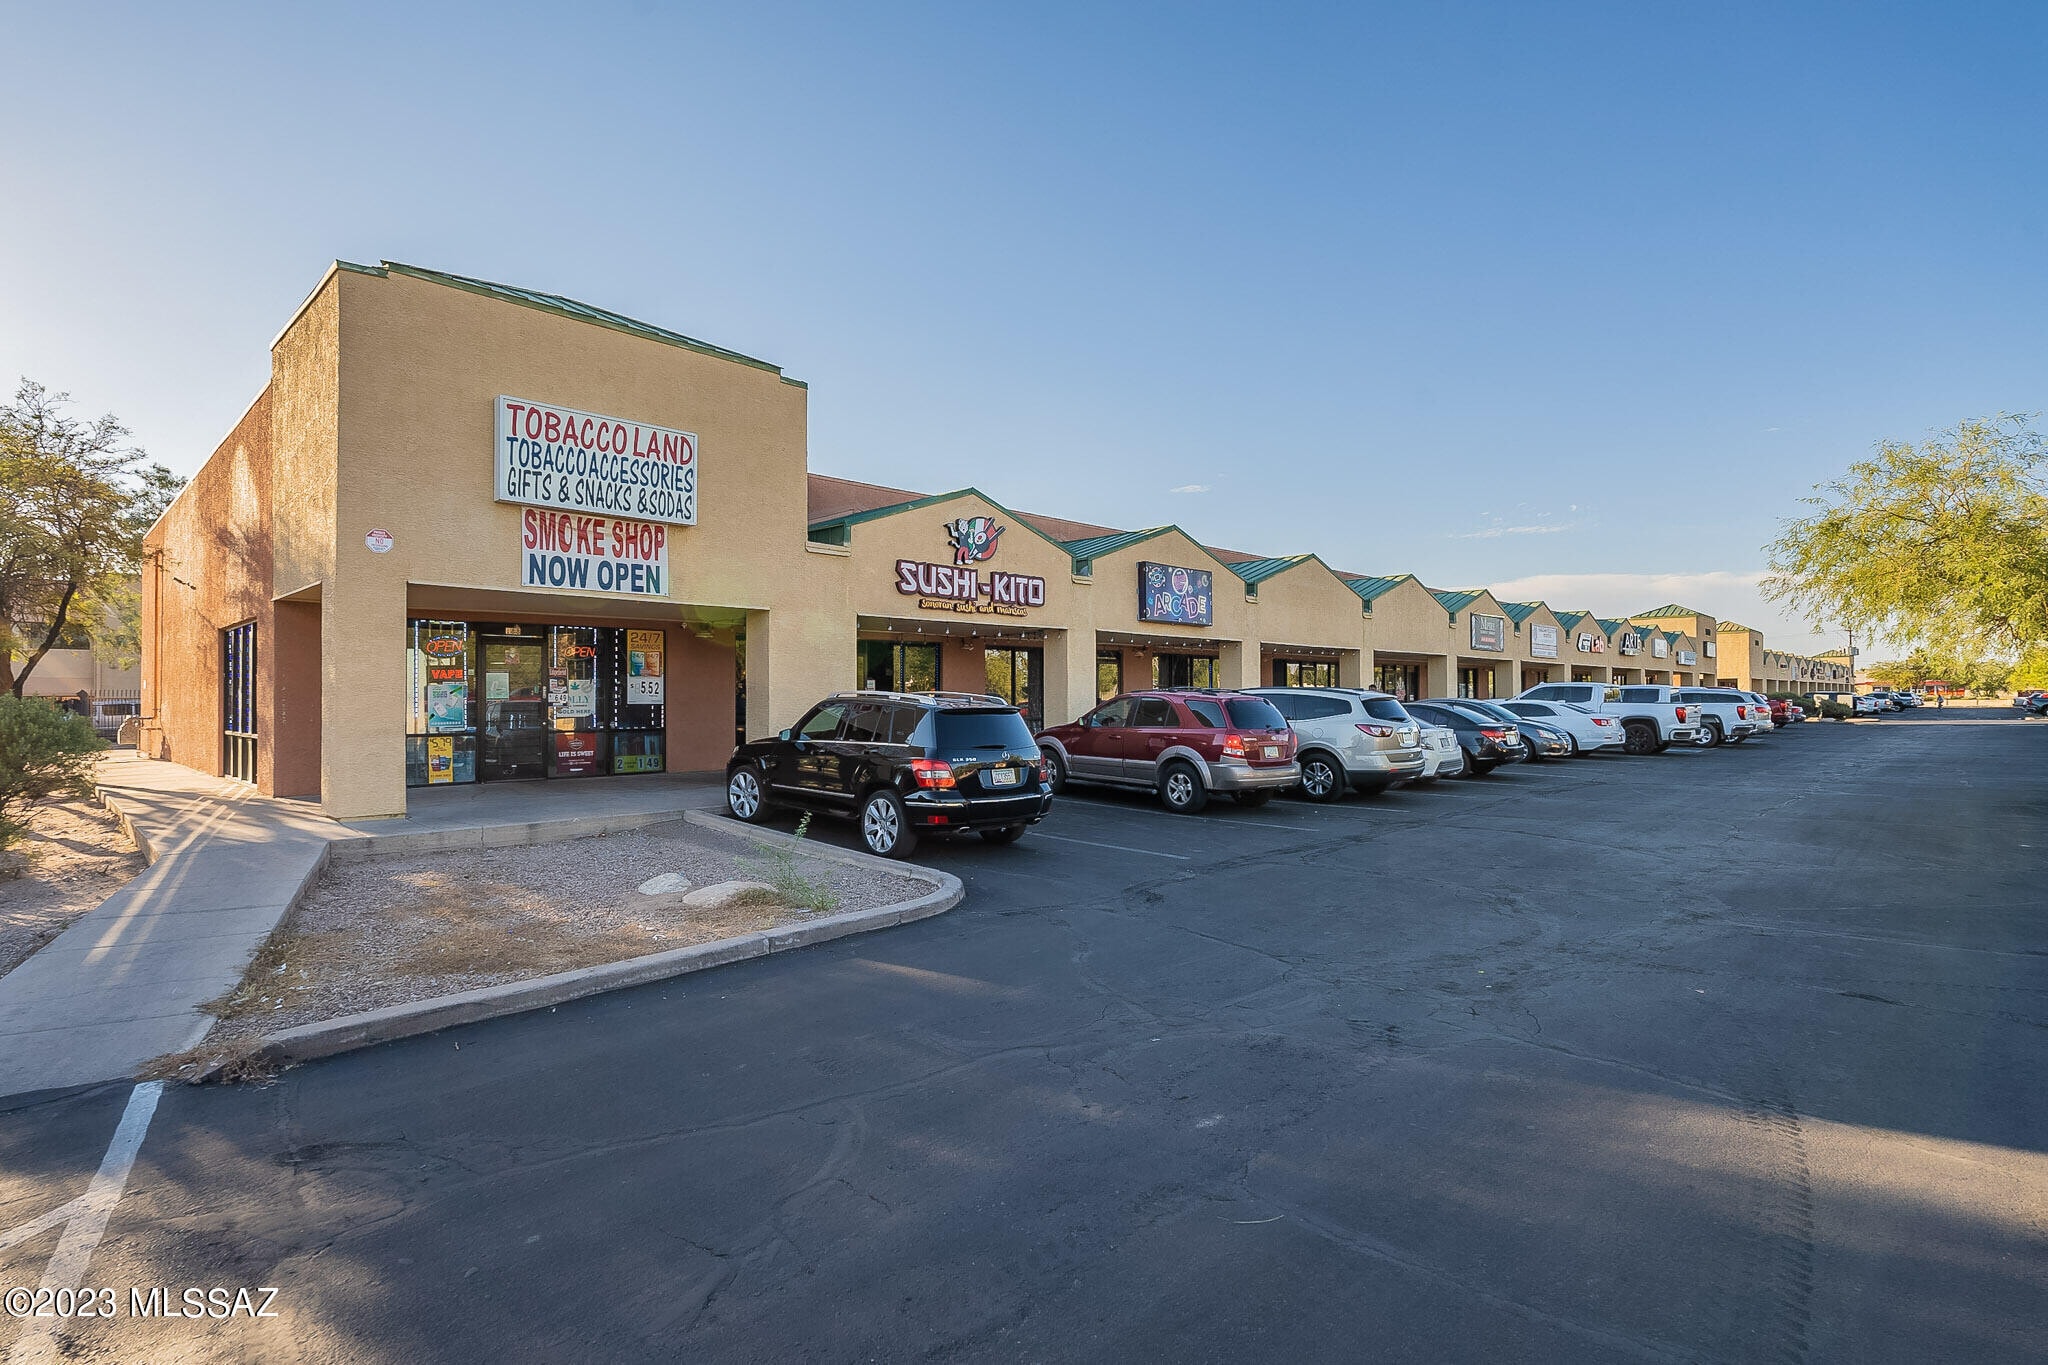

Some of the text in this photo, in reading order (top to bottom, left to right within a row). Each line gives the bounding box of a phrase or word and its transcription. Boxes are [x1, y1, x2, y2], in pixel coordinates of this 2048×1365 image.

[506, 403, 693, 466] TOBACCO LAND
[507, 466, 552, 501] GIFTS
[558, 475, 570, 503] &
[575, 478, 632, 512] SNACKS
[524, 508, 665, 561] SMOKE SHOP
[529, 553, 661, 594] NOW OPEN
[898, 561, 1045, 605] SUSHI-KITO
[956, 600, 977, 613] sushi
[979, 602, 994, 614] and
[1153, 592, 1207, 618] ARCADE
[426, 640, 463, 653] OPEN
[630, 632, 661, 643] 24/7
[564, 646, 596, 658] OPEN
[431, 669, 464, 679] VAPE
[640, 681, 660, 695] 5.52
